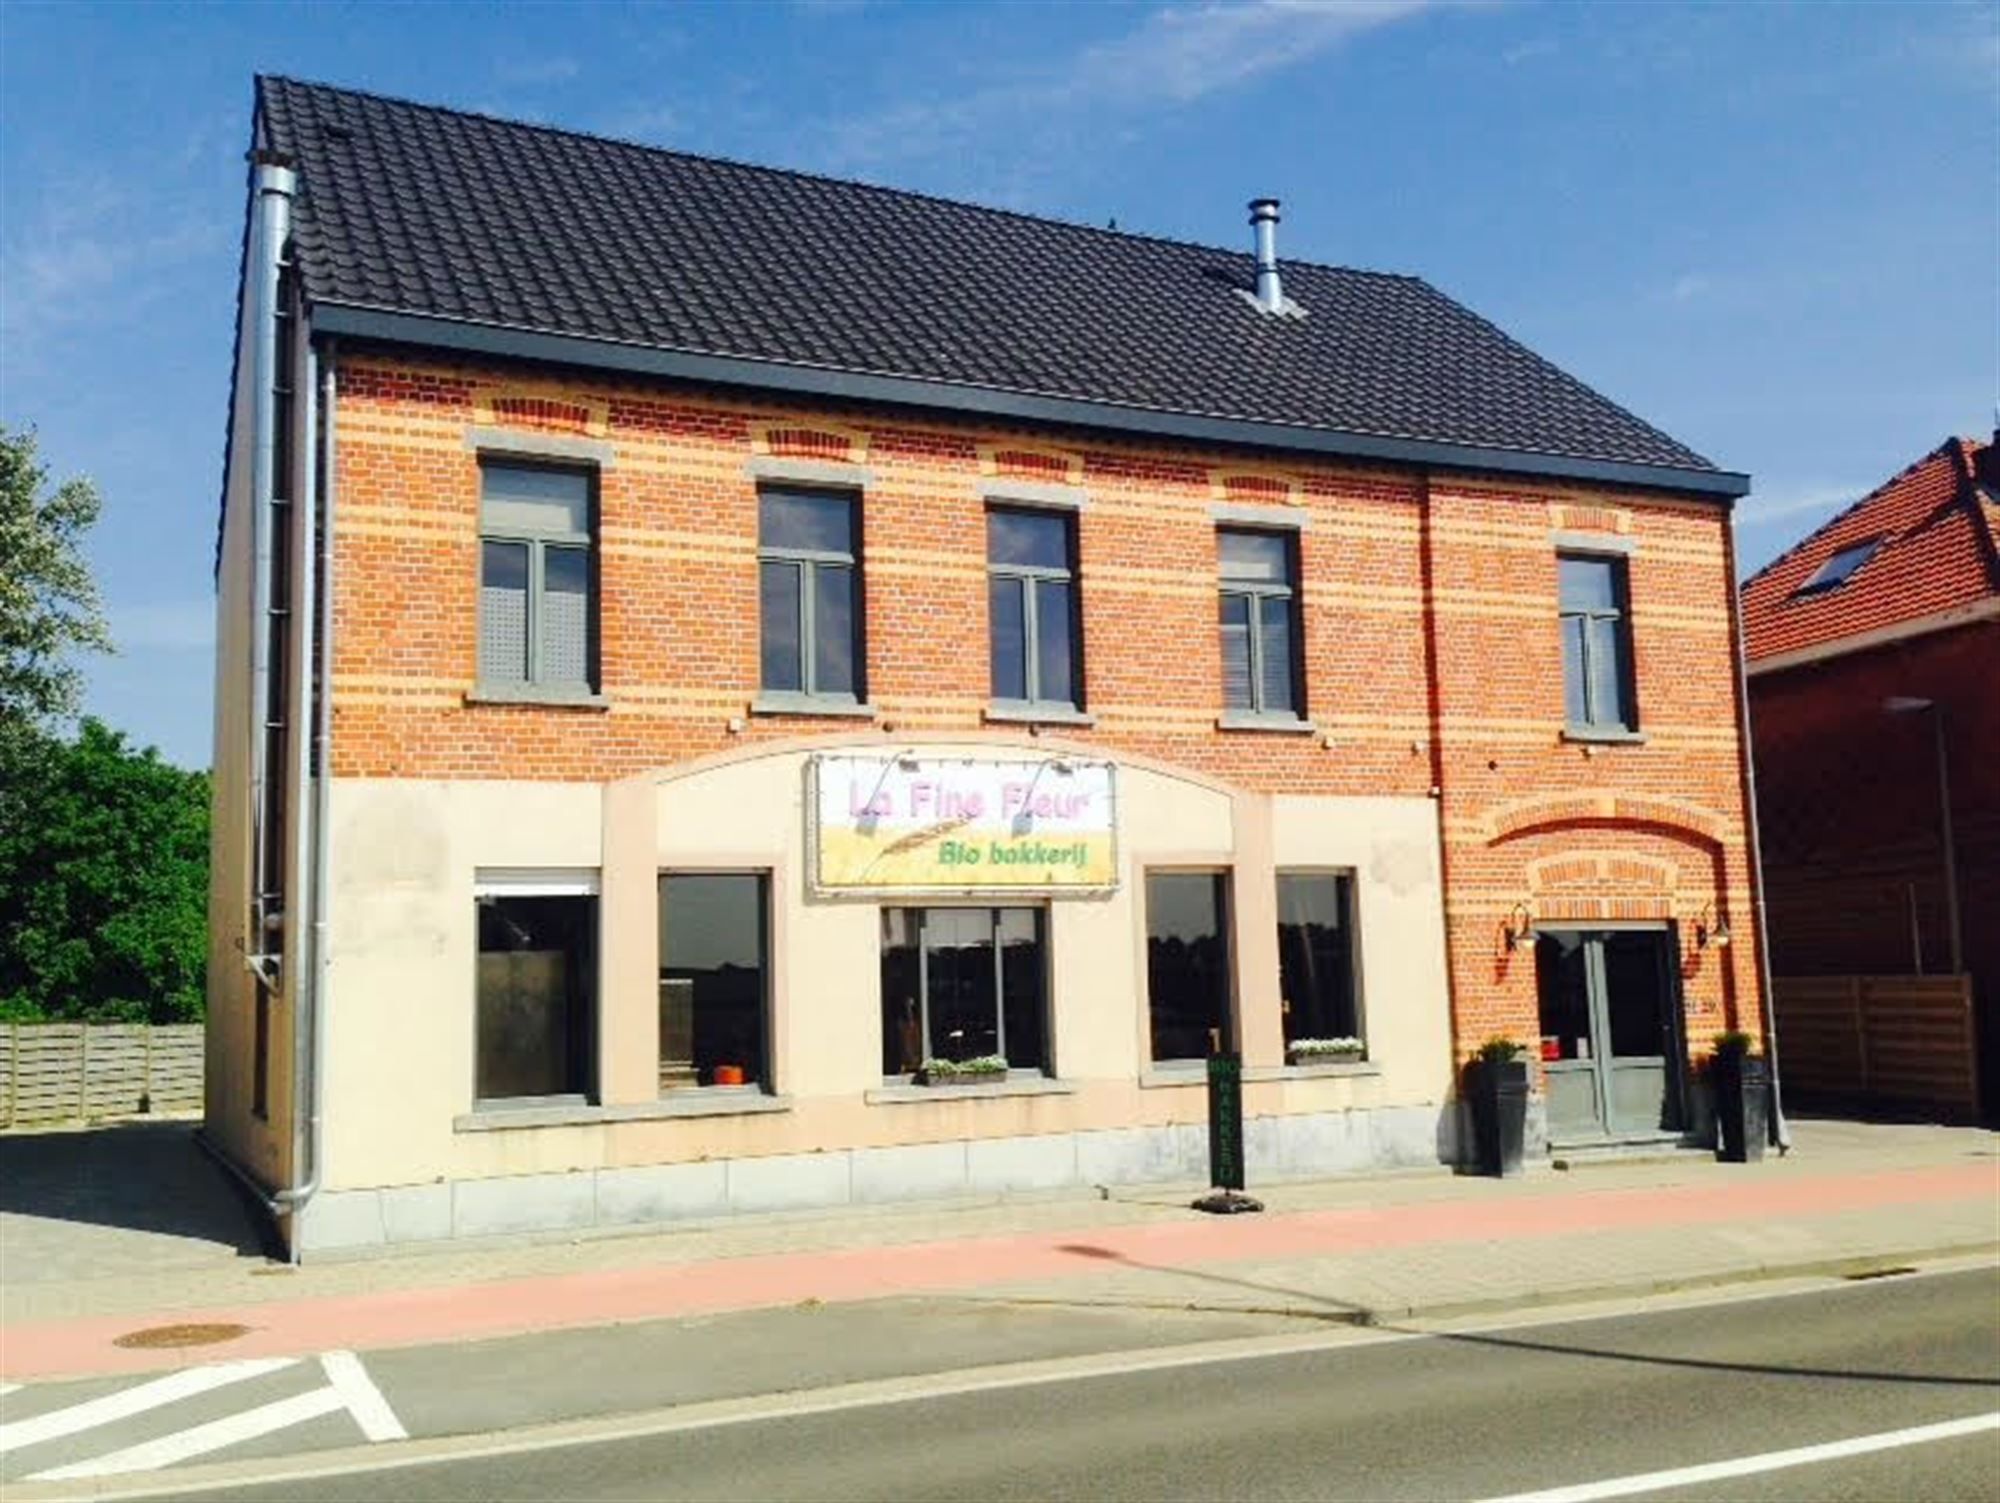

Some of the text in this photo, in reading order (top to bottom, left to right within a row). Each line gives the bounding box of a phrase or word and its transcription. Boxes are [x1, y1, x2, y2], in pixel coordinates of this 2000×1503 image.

[850, 779, 1089, 820] La Fine Fleur
[938, 841, 1088, 869] Bio bakkerij
